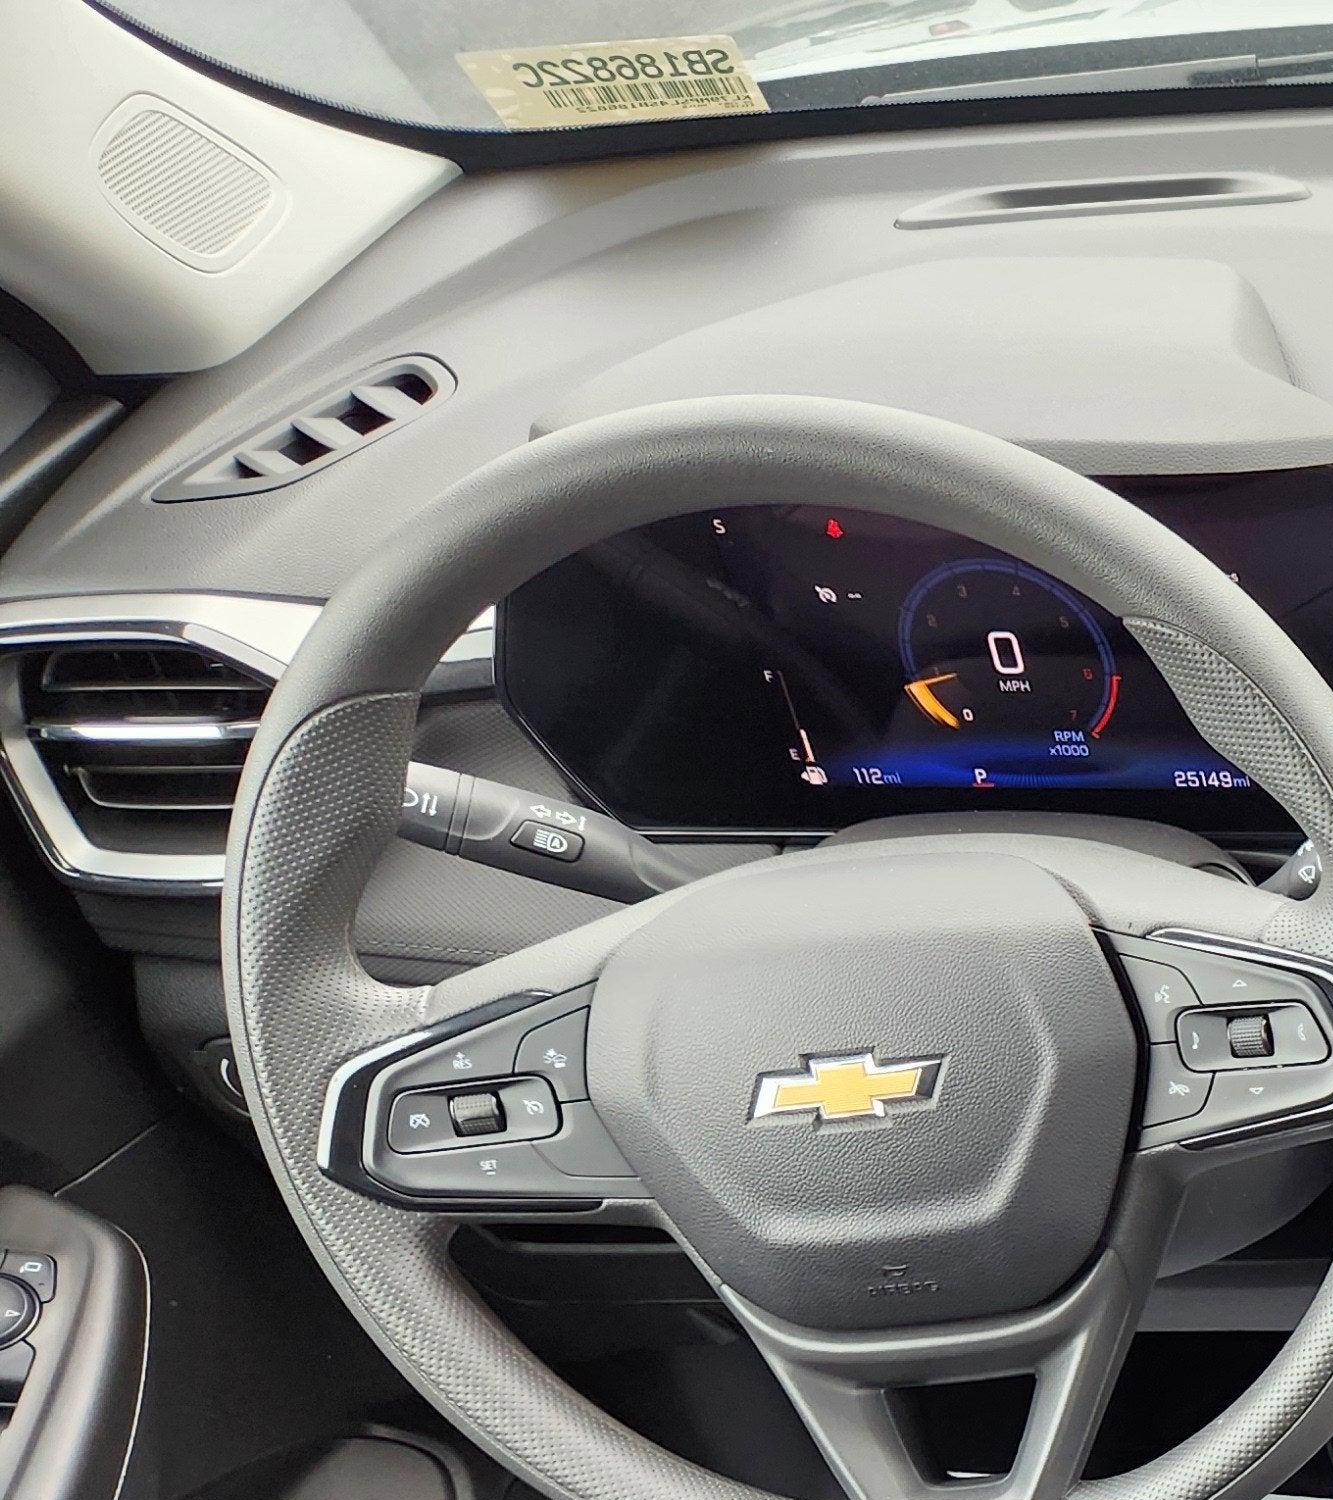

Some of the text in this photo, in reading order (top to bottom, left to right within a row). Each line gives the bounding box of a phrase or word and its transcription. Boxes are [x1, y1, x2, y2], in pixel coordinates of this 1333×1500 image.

[987, 631, 1025, 674] 0
[763, 670, 773, 683] F
[999, 680, 1031, 692] MPH
[962, 708, 973, 722] 0
[1054, 730, 1085, 742] RPM
[789, 748, 800, 761] E
[1050, 744, 1090, 757] x1000
[974, 768, 987, 784] P
[453, 1059, 472, 1070] RES
[480, 1159, 497, 1171] SET
